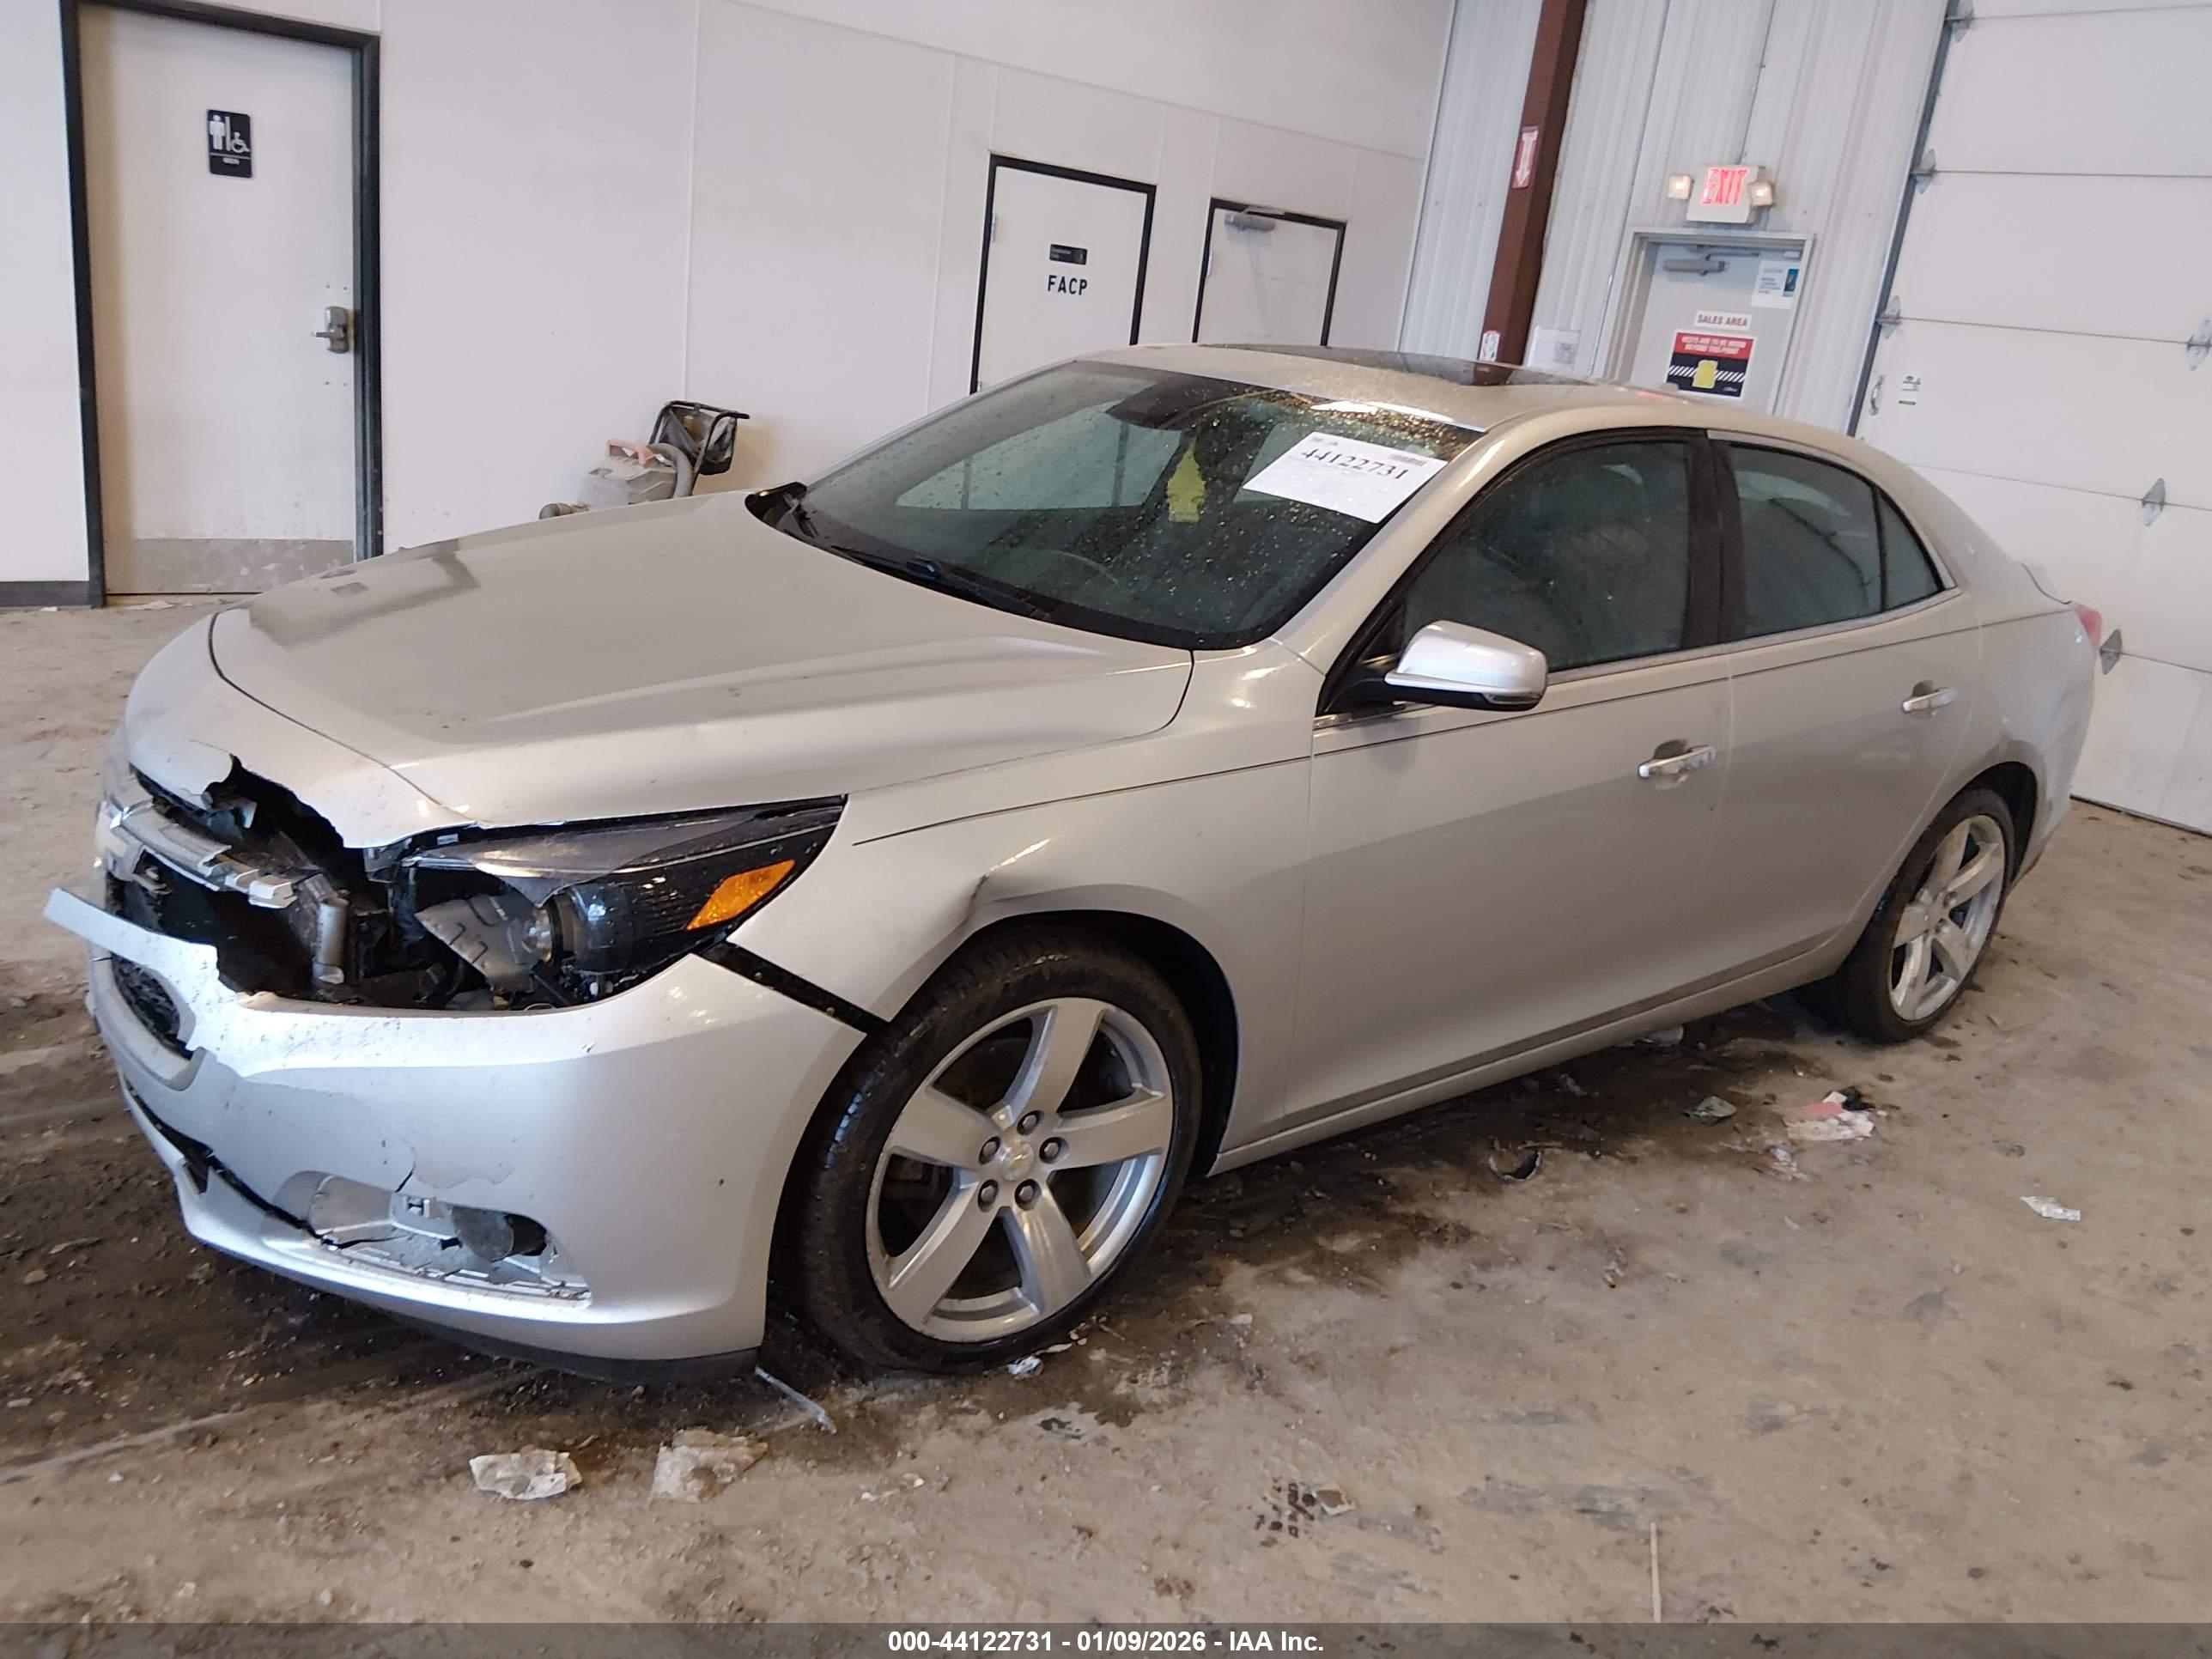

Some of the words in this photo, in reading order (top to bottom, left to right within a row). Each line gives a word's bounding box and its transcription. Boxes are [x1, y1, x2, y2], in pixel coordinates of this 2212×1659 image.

[1703, 168, 1748, 204] EXIT
[1048, 274, 1087, 295] FACP
[1698, 314, 1723, 325] SALES
[1725, 317, 1747, 326] AREA
[1301, 448, 1408, 479] 44122731
